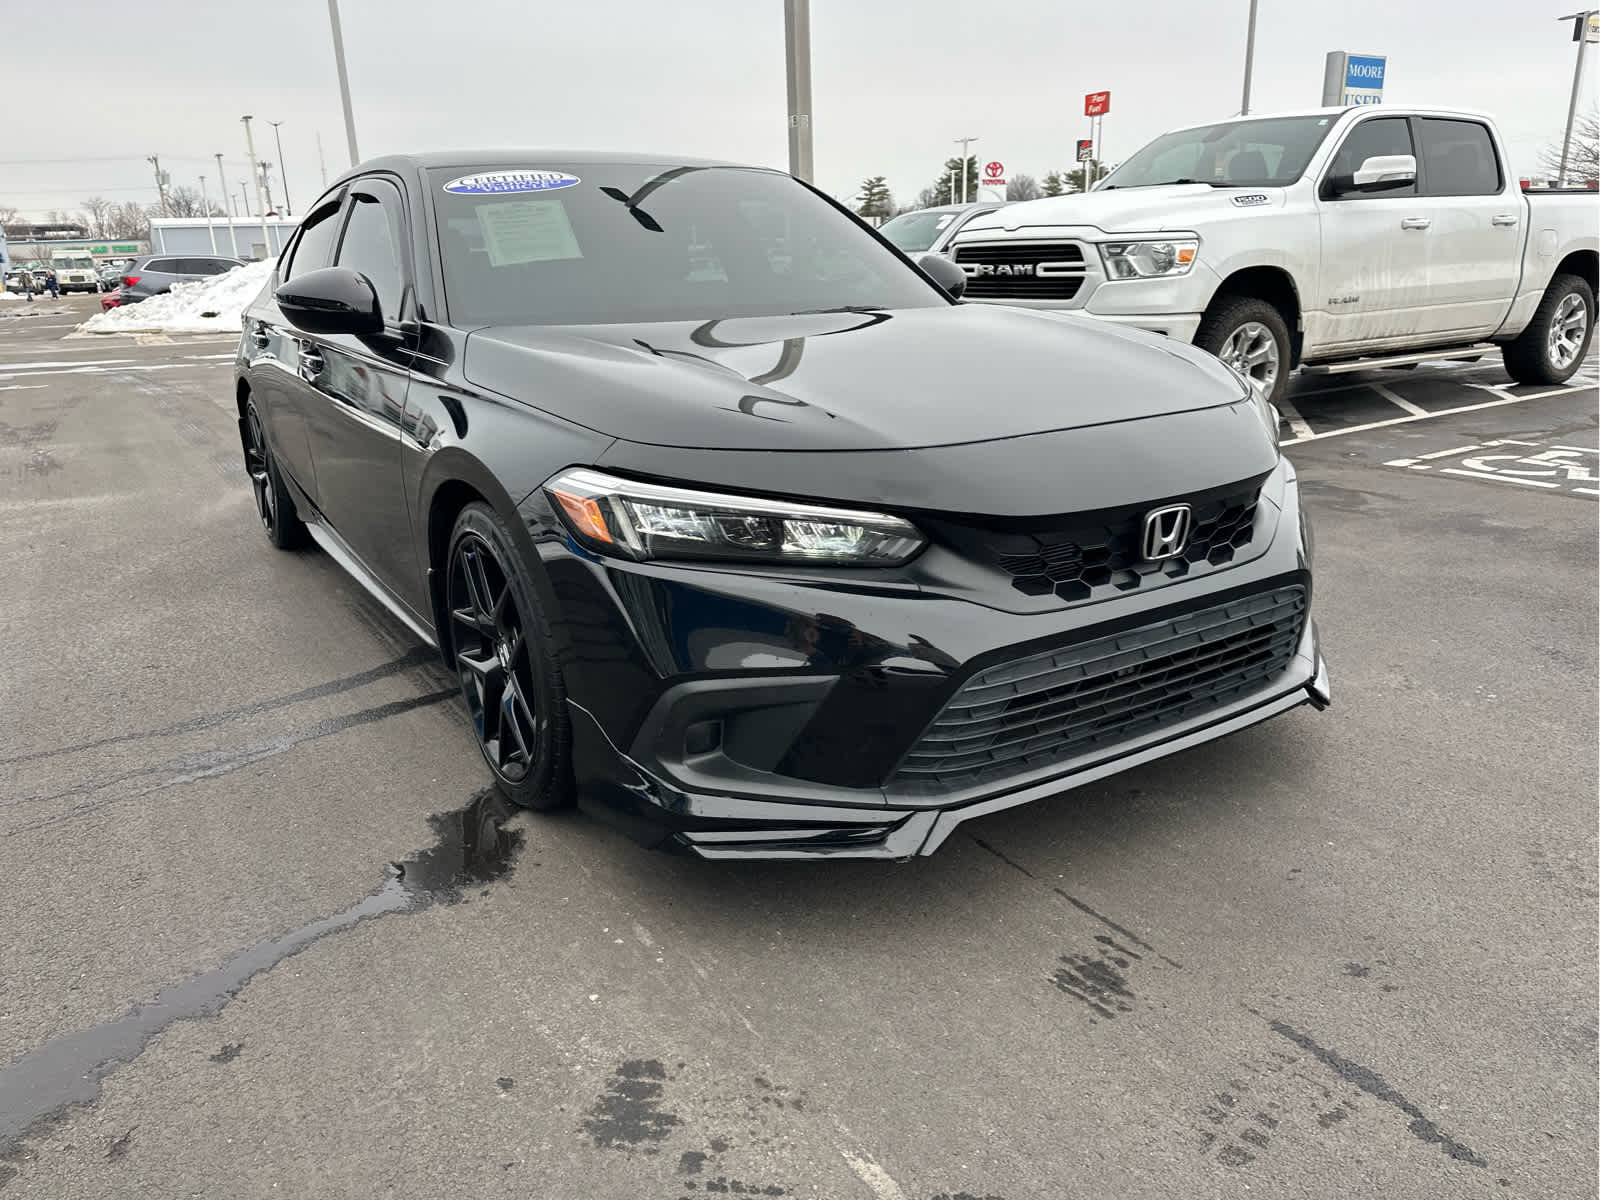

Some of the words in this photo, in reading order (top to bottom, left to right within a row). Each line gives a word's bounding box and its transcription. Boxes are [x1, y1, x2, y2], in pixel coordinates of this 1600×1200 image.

[1350, 64, 1383, 79] MOORE
[459, 174, 564, 186] CERTIFIED
[979, 264, 1034, 276] RAM
